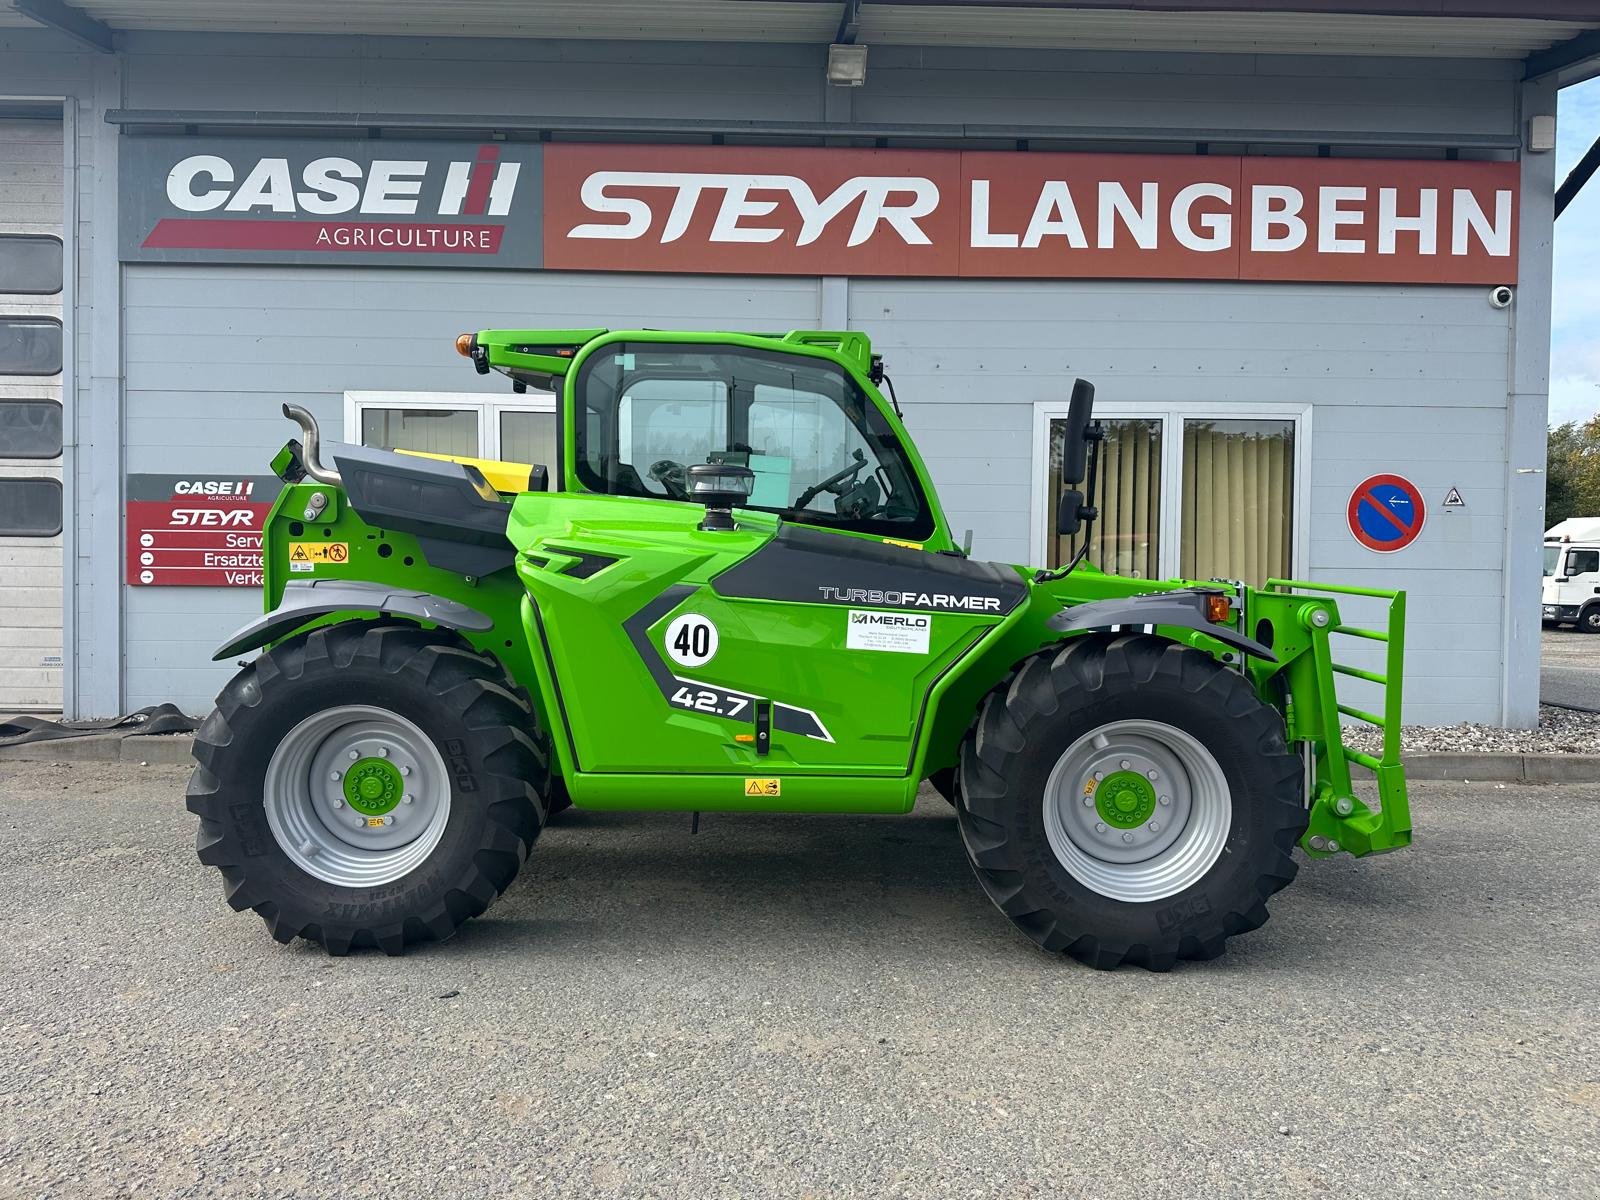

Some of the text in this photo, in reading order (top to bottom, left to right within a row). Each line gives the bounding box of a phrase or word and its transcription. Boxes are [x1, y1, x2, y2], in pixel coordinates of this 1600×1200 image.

[166, 154, 428, 215] CASE
[567, 171, 940, 247] STEYR
[970, 179, 1513, 257] LANGBEHN
[315, 227, 491, 249] AGRICULTURE
[174, 481, 234, 495] CASE
[168, 508, 255, 526] STEYR
[818, 586, 1001, 611] TURBOFARMER
[869, 615, 928, 628] MERLO
[673, 623, 710, 658] 40
[670, 686, 749, 717] 42.7
